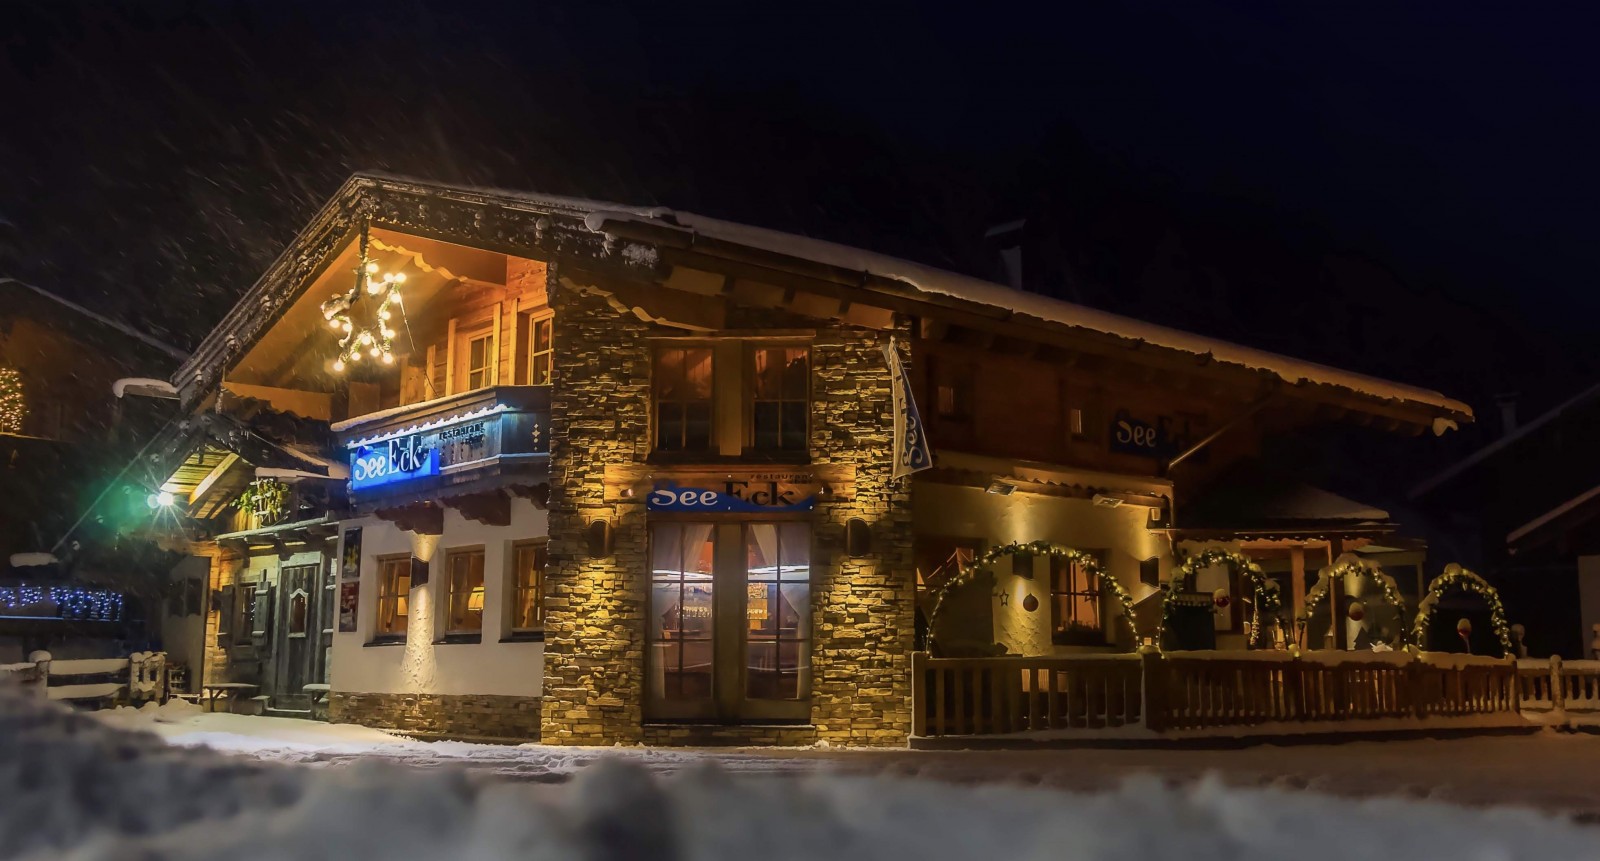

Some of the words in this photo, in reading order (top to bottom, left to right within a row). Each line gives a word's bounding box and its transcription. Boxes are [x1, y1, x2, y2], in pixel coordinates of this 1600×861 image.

[439, 420, 485, 440] restaurant
[1116, 420, 1157, 448] See
[354, 455, 386, 481] See
[387, 434, 422, 475] Eck
[651, 489, 718, 506] See
[722, 481, 795, 506] Eck
